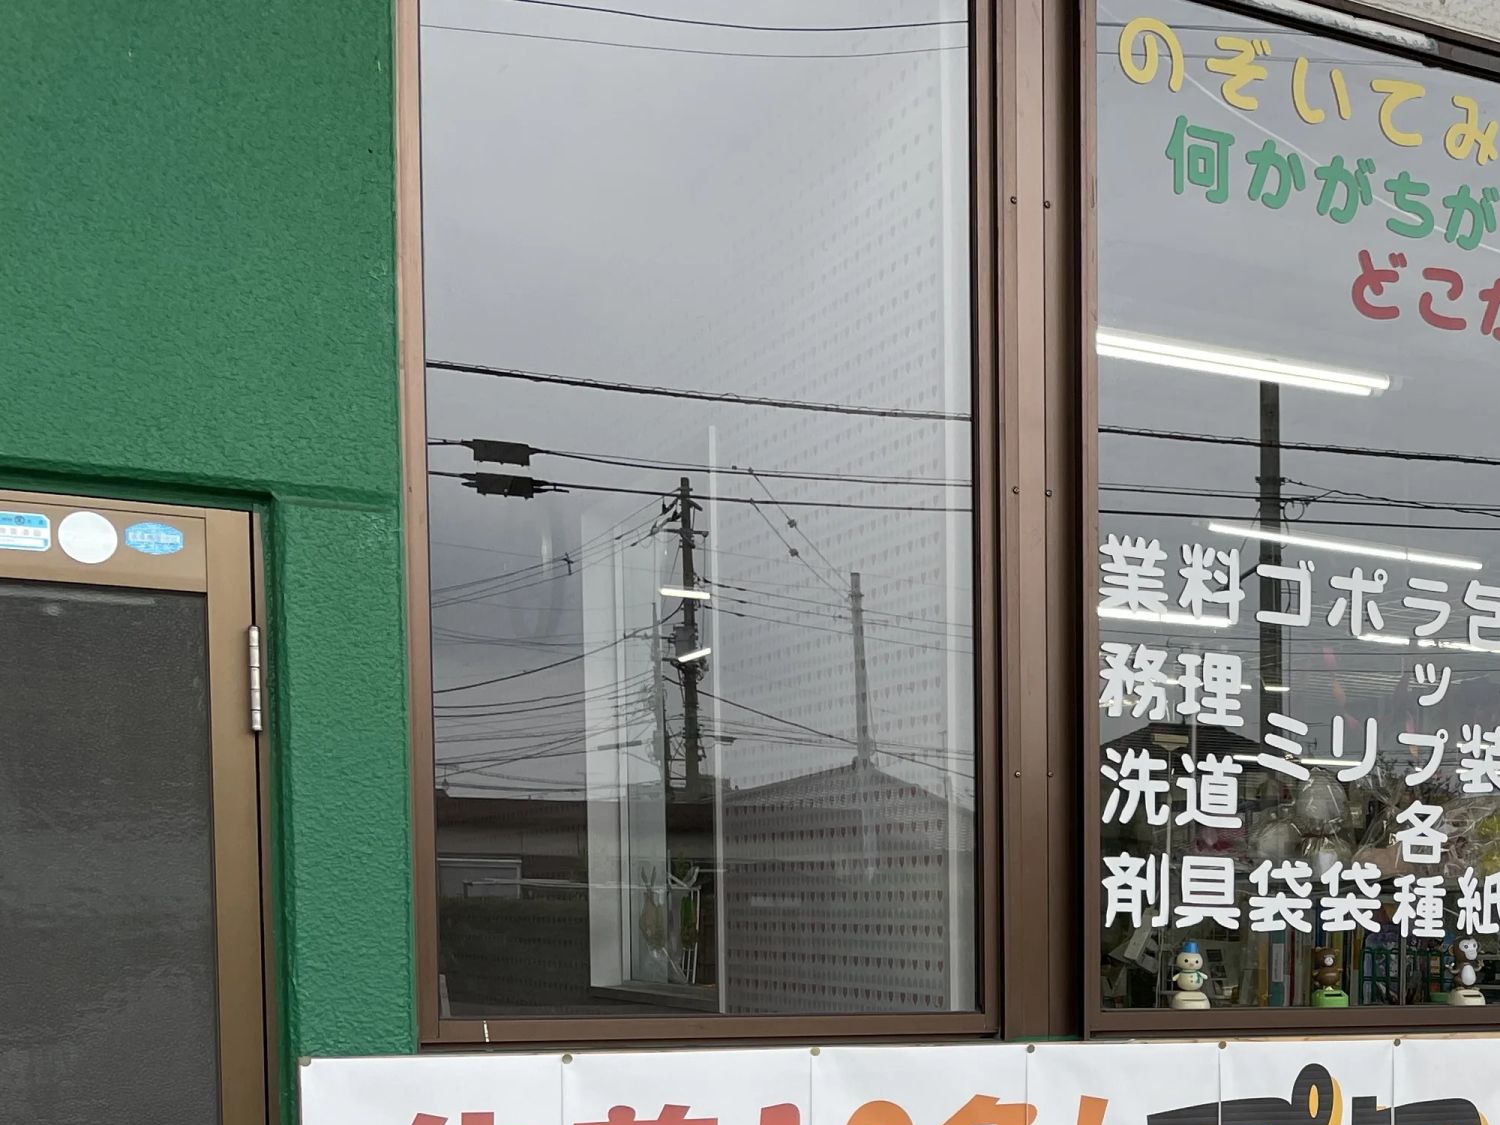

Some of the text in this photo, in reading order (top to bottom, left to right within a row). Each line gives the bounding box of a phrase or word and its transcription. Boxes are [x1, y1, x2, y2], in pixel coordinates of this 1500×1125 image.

[1098, 532, 1170, 929] 業務洗剤
[1175, 542, 1246, 931] 料理道具
[1248, 558, 1316, 933] ゴミ袋
[1319, 566, 1389, 934] ポリ袋
[1391, 576, 1453, 939] ラップ各種
